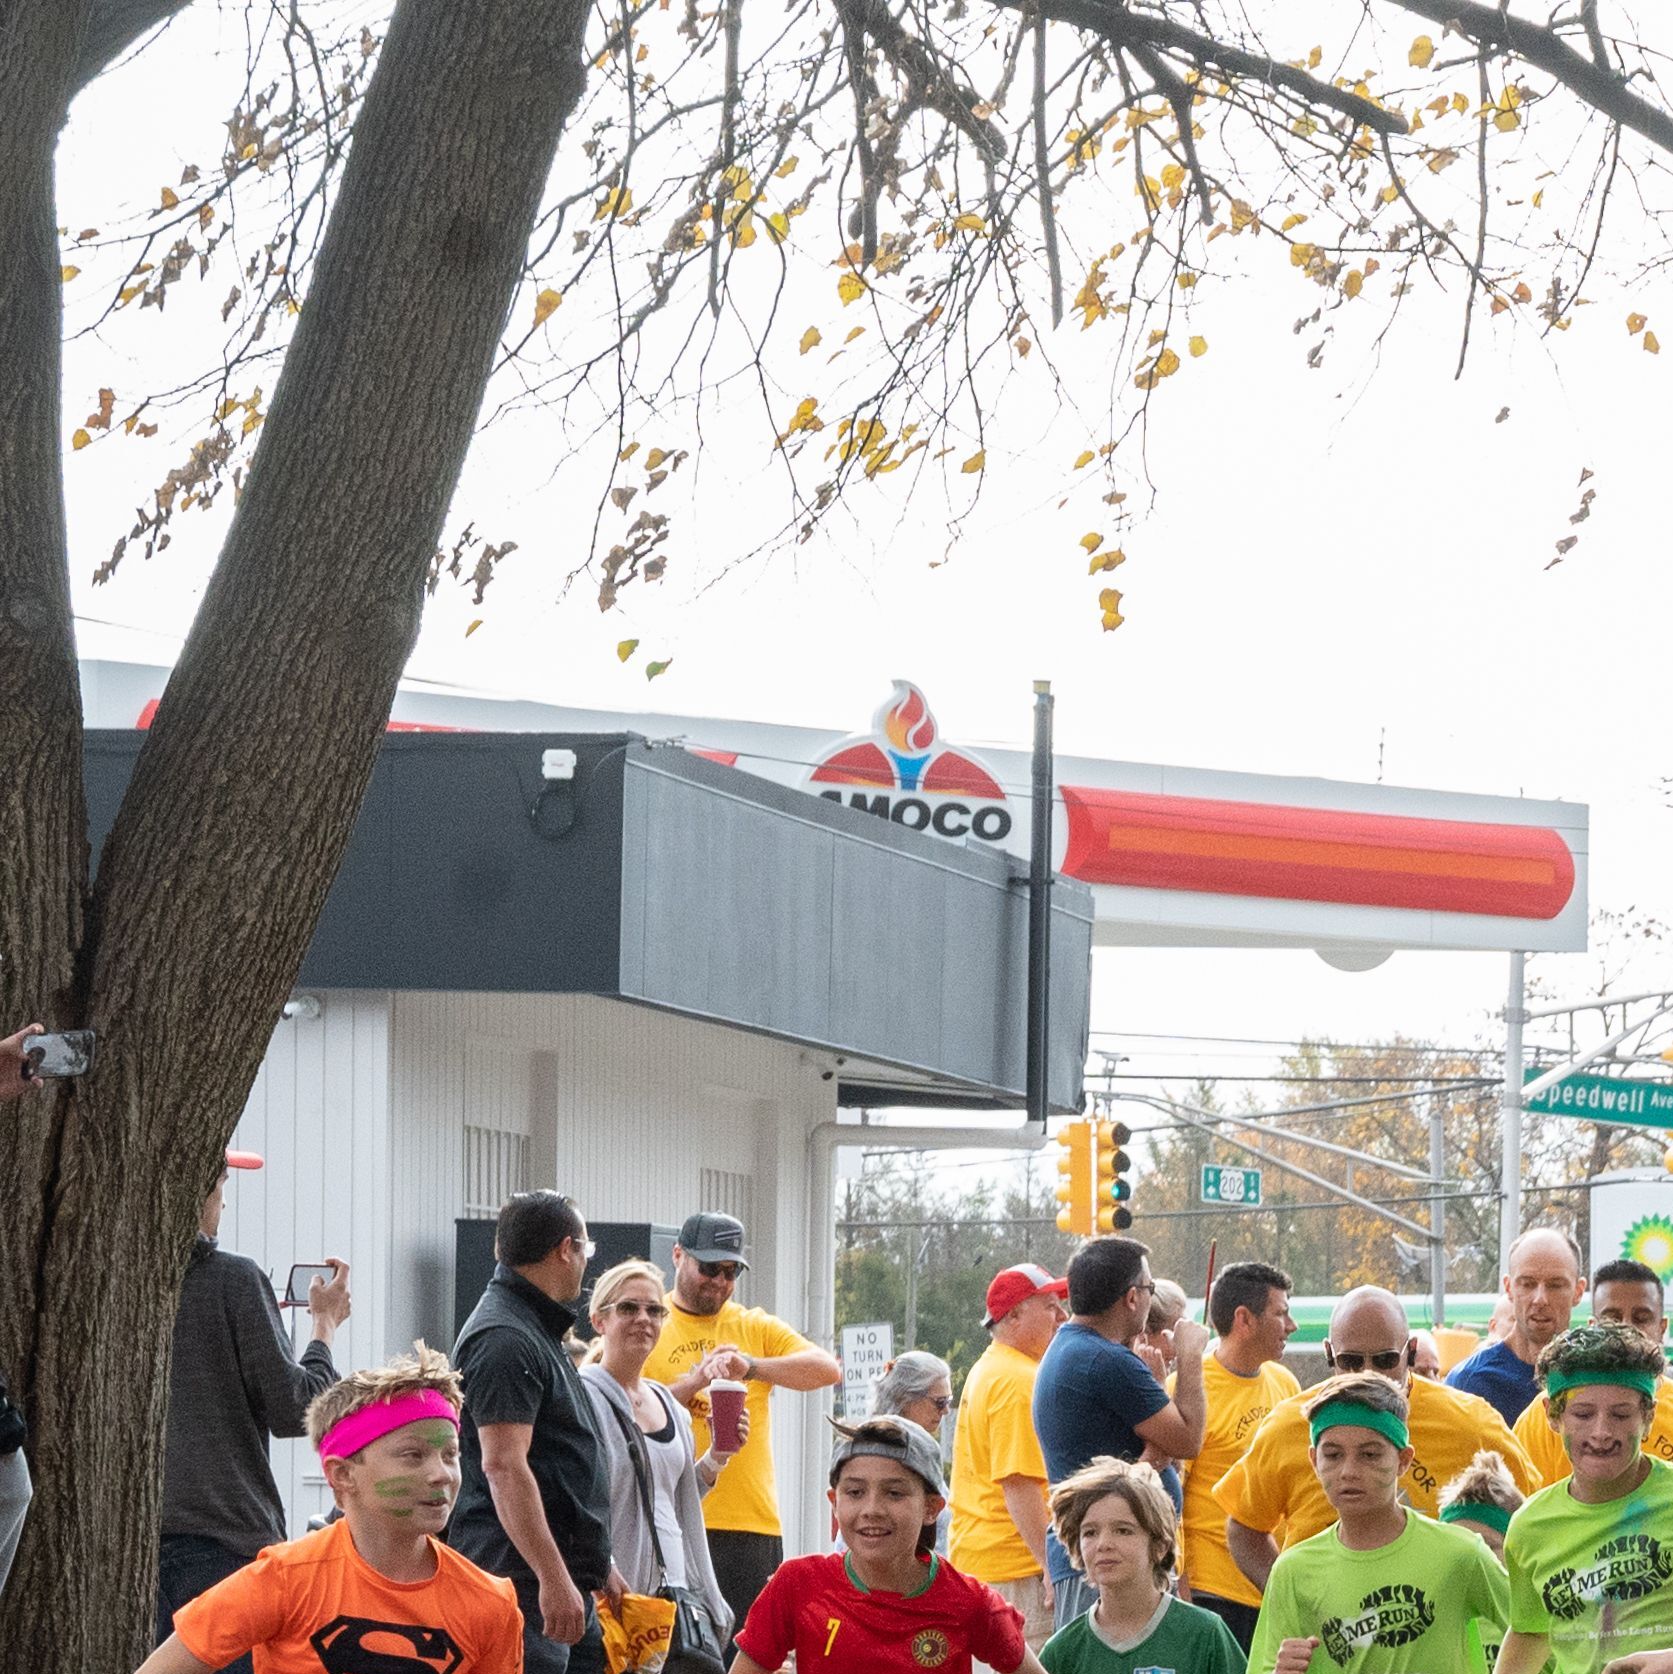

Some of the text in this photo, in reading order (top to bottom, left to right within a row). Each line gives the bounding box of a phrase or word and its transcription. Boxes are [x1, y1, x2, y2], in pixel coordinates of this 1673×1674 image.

[1651, 1090, 1673, 1109] Ave
[1221, 1176, 1243, 1195] 202
[856, 1332, 877, 1345] NO
[853, 1349, 883, 1363] TURN
[846, 1367, 862, 1382] ON
[1577, 1567, 1607, 1593] ME
[1607, 1558, 1649, 1580] RUN
[1344, 1615, 1378, 1641] ME
[1378, 1608, 1415, 1629] RUN
[1655, 1624, 1673, 1633] Run
[824, 1617, 841, 1656] 7
